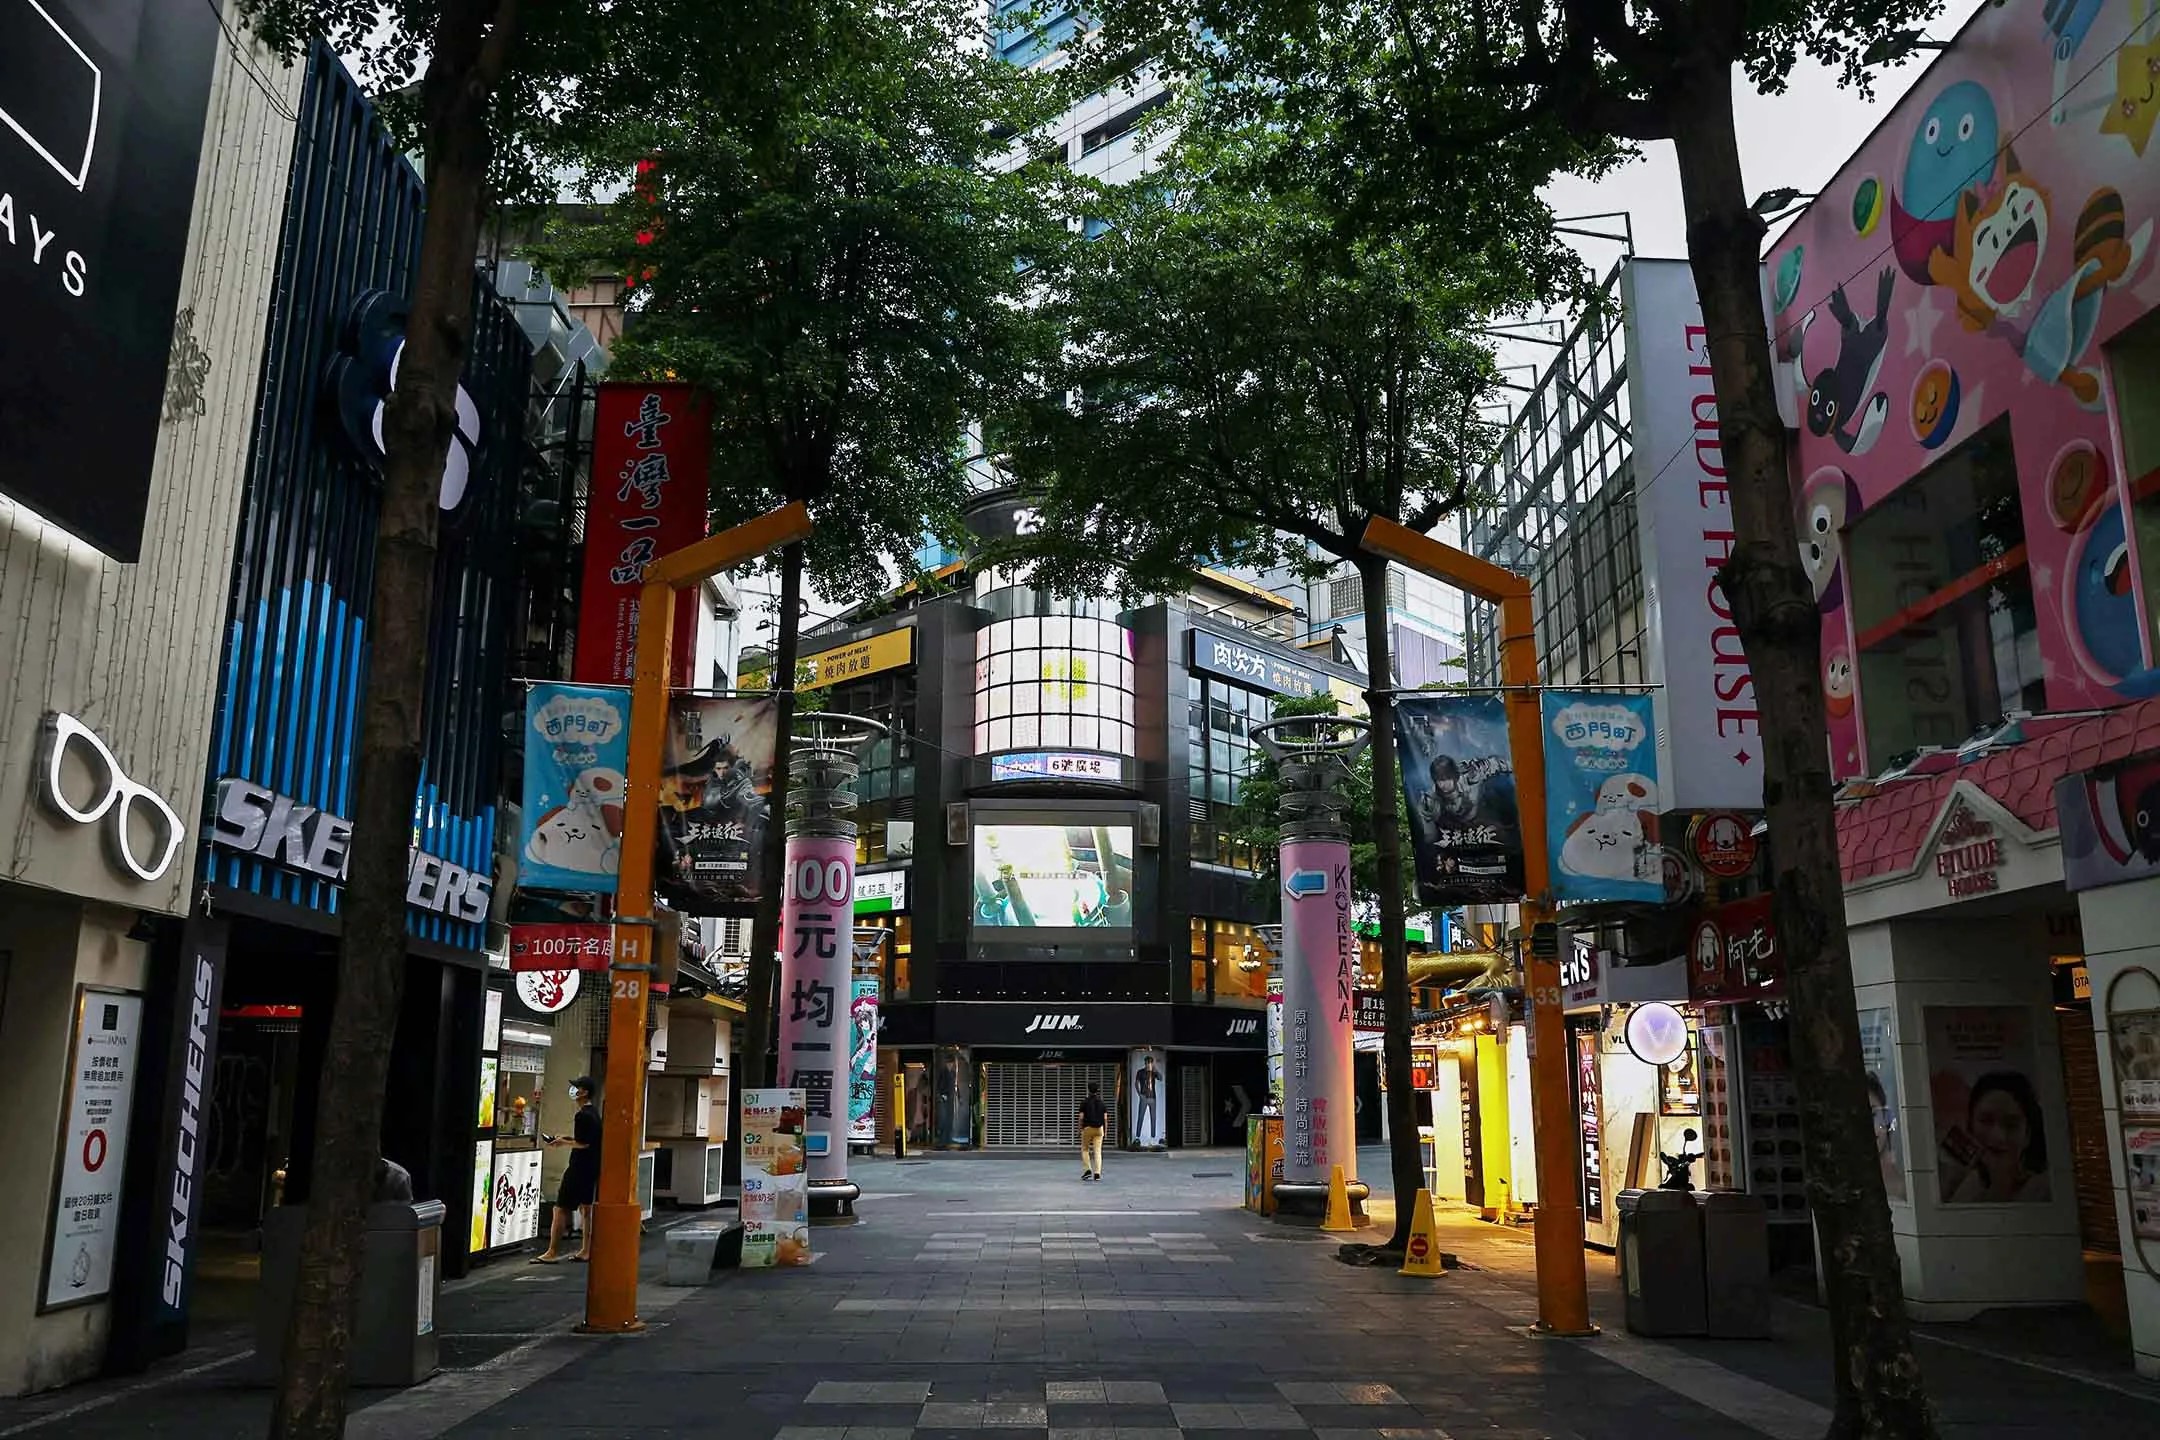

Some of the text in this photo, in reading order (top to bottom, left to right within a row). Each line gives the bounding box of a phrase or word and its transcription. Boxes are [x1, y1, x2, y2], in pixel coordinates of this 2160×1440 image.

[1213, 641, 1267, 681] 肉次方
[546, 714, 613, 736] 西門町
[1565, 722, 1636, 742] 西門町
[211, 778, 493, 923] SKEERS
[622, 940, 637, 958] H
[1334, 863, 1350, 1024] KOREANA
[614, 980, 640, 999] 28
[1536, 987, 1561, 1005] 33
[1025, 1015, 1080, 1033] JUN
[1226, 1019, 1257, 1036] JUN
[163, 954, 213, 1309] SKECHERS
